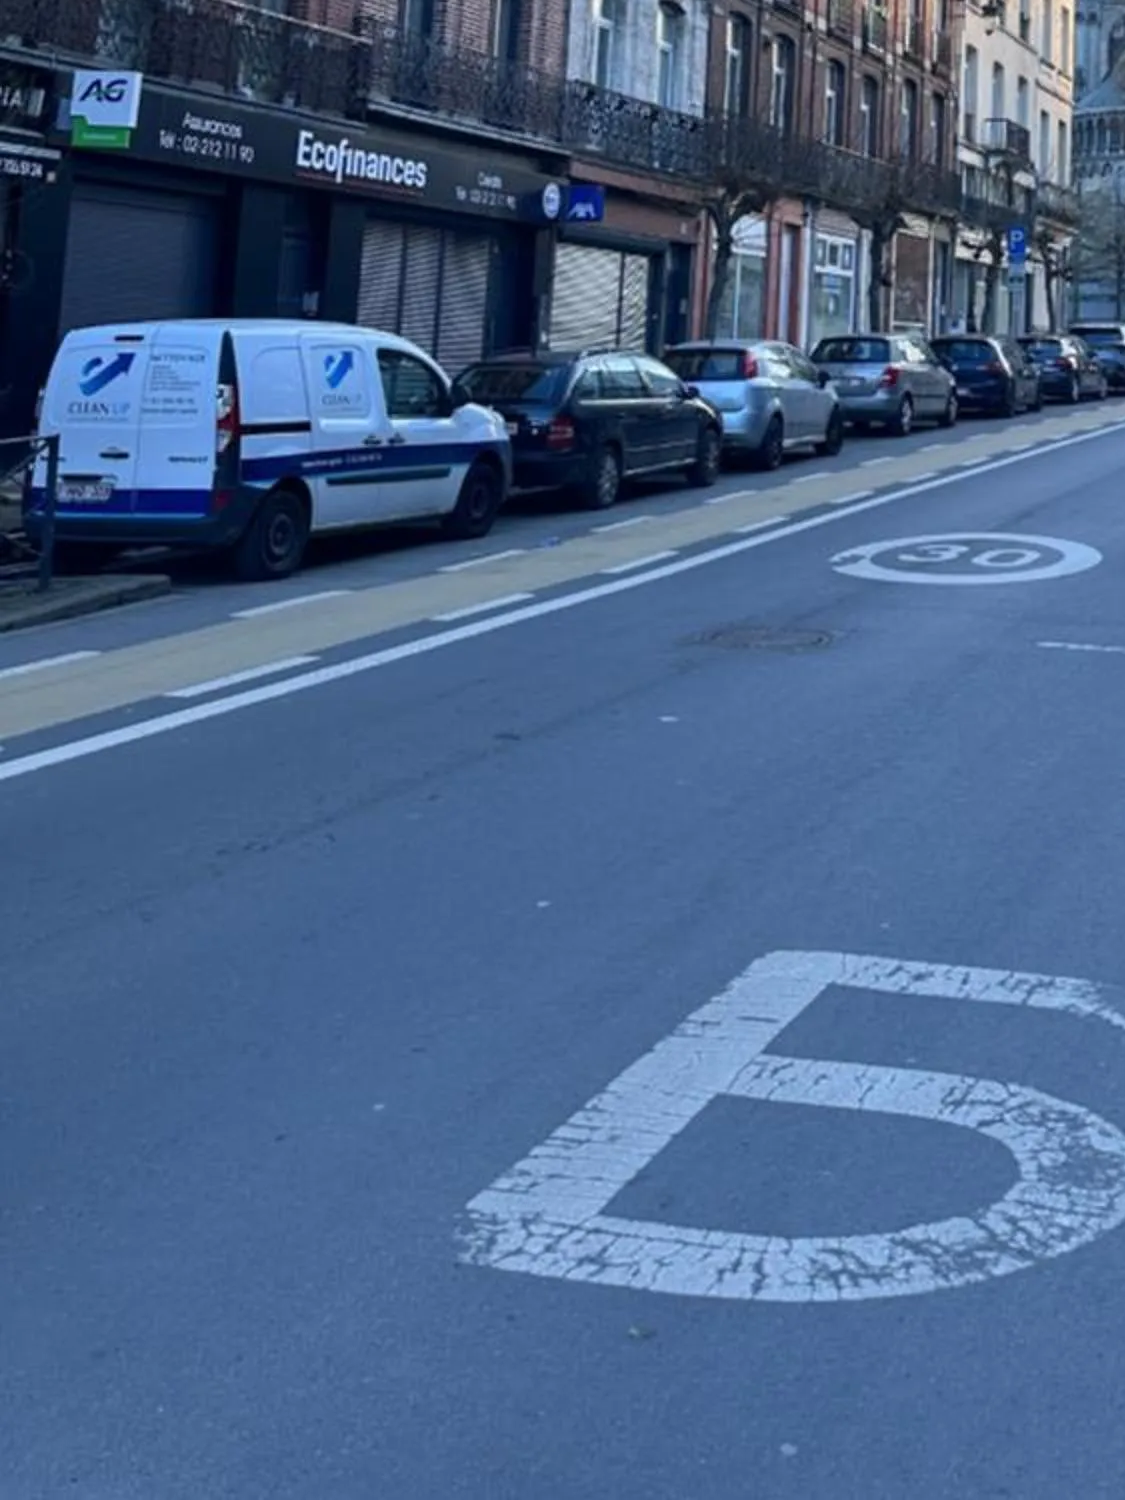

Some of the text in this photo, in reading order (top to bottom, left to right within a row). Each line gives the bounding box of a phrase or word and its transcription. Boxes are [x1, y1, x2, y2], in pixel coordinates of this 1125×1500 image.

[80, 78, 128, 103] AG
[296, 129, 428, 188] Ecofinances
[1010, 229, 1025, 249] P
[897, 544, 1041, 568] 30
